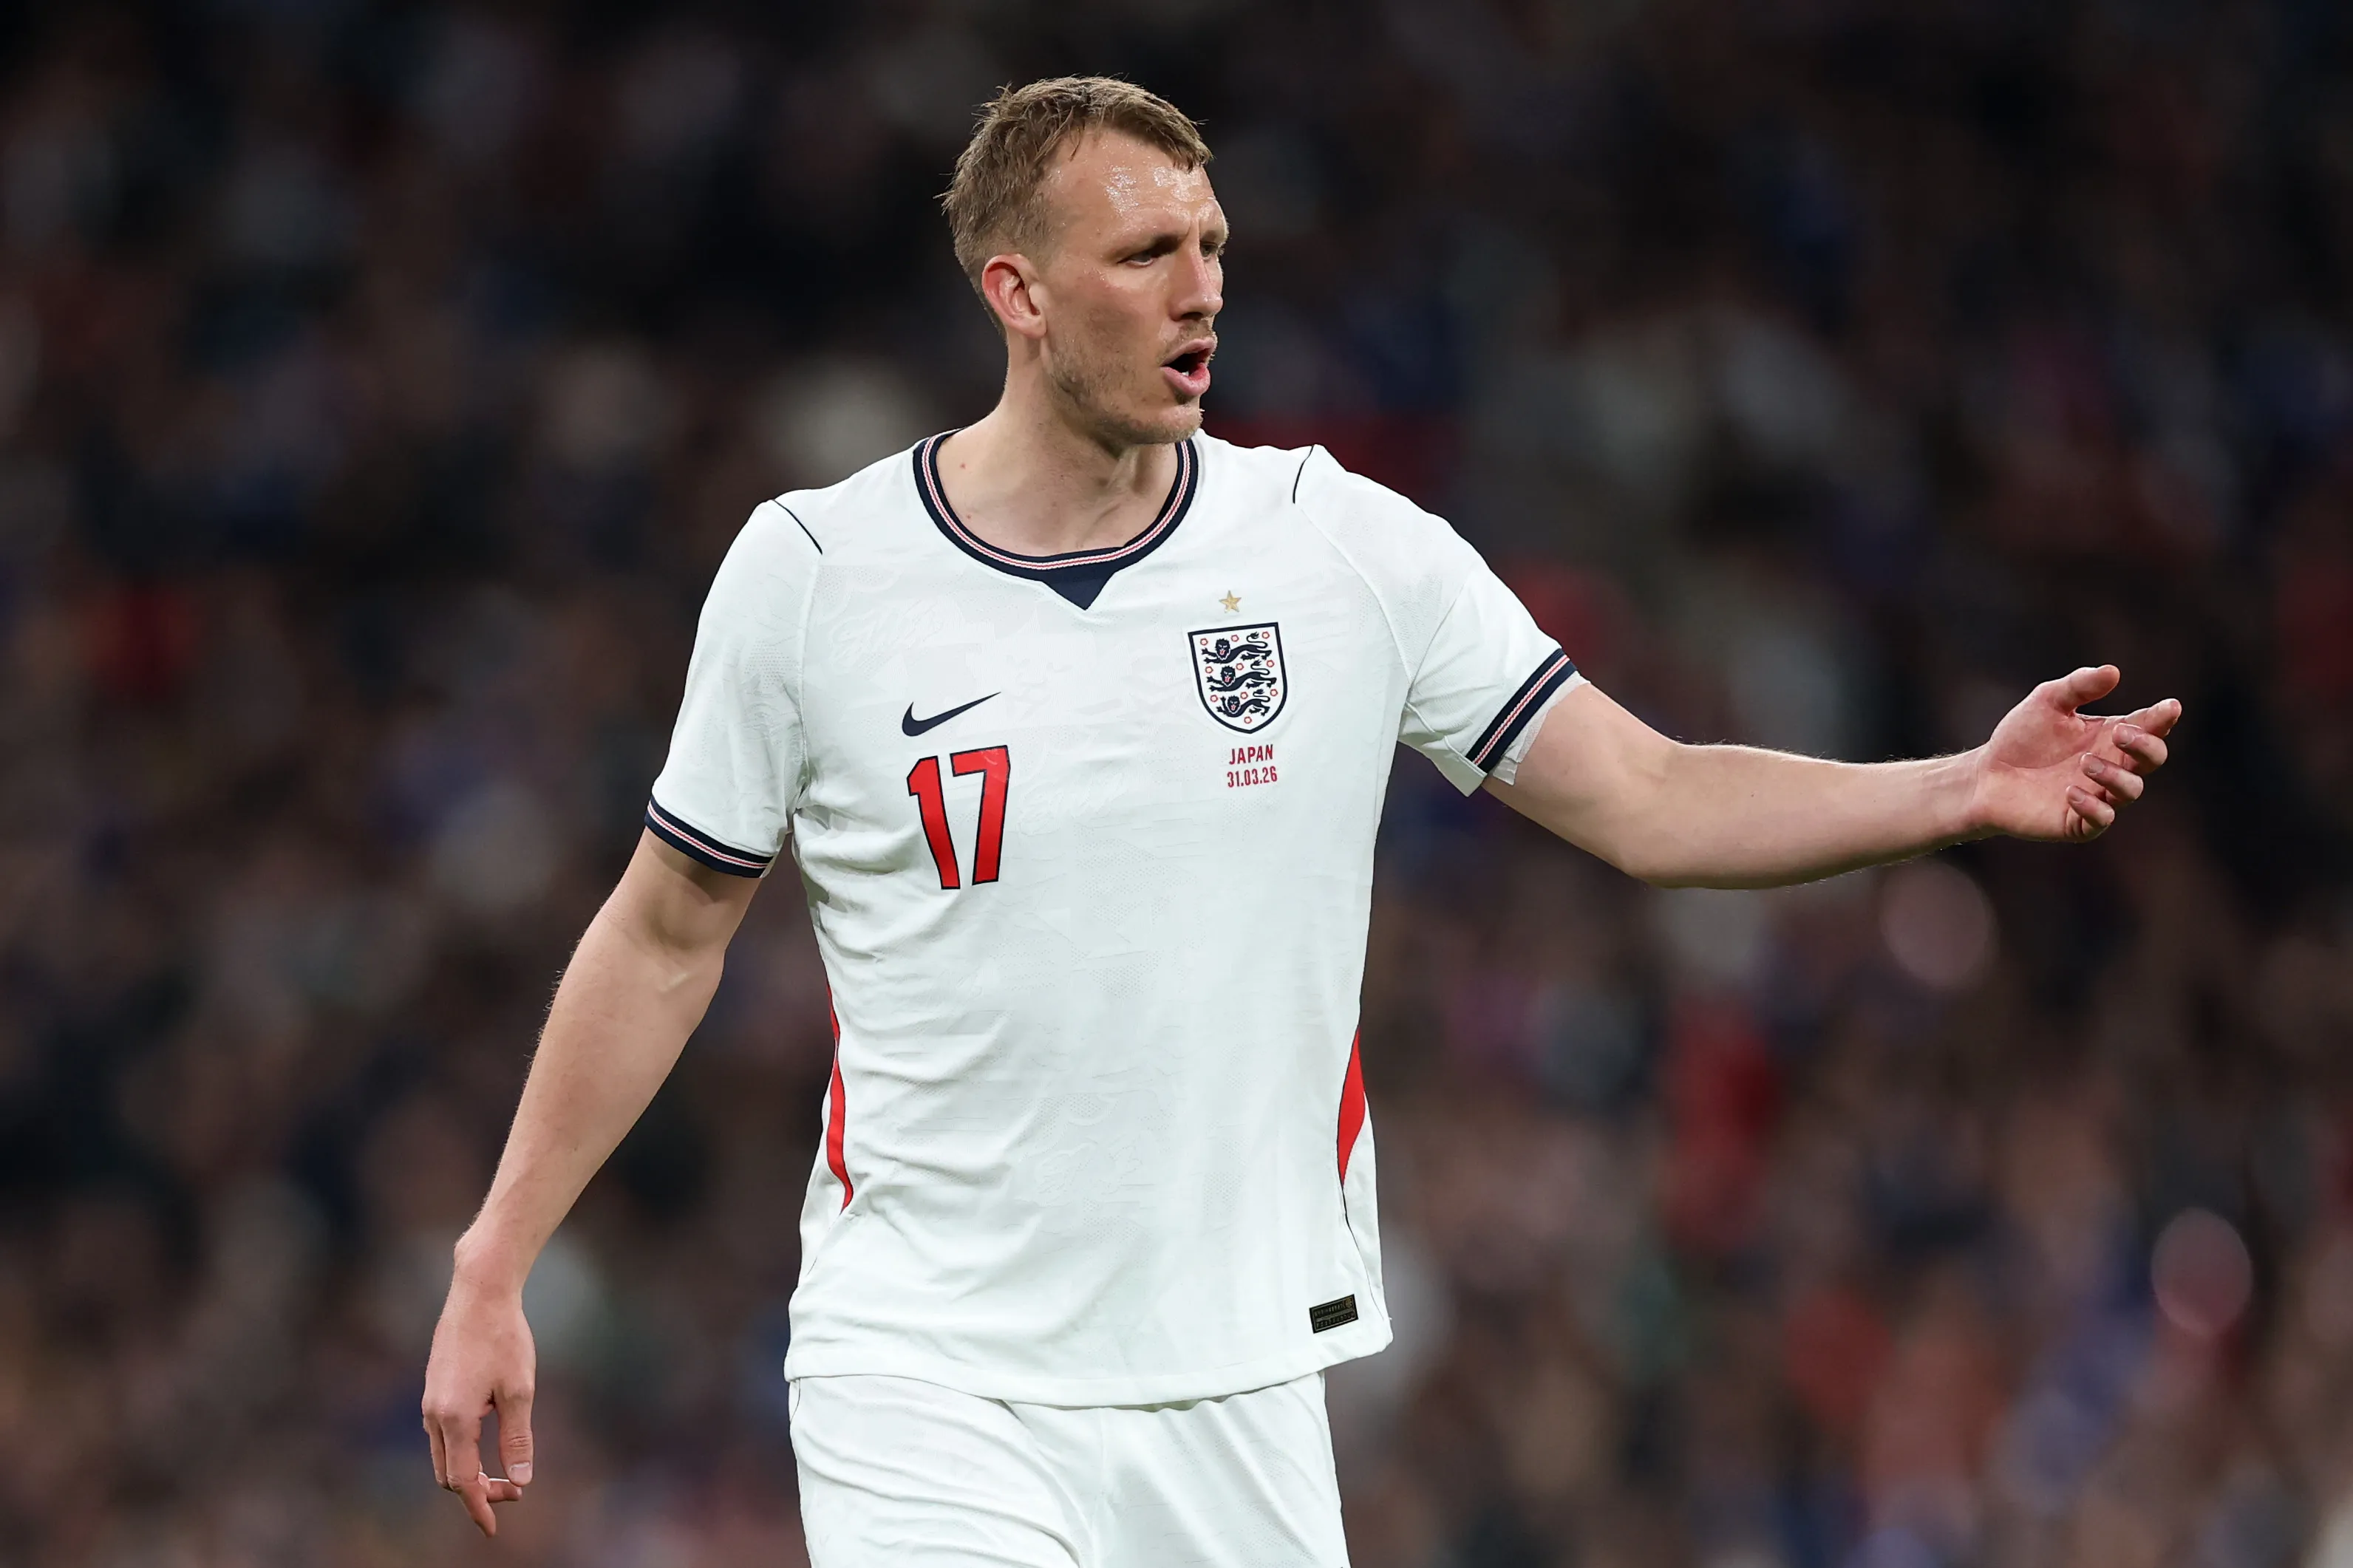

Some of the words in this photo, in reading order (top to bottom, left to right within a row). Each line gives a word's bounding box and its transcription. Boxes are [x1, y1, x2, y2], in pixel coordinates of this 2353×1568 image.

[1229, 743, 1273, 765] JAPAN
[1227, 766, 1278, 788] 31.03.26
[906, 745, 1011, 890] 17
